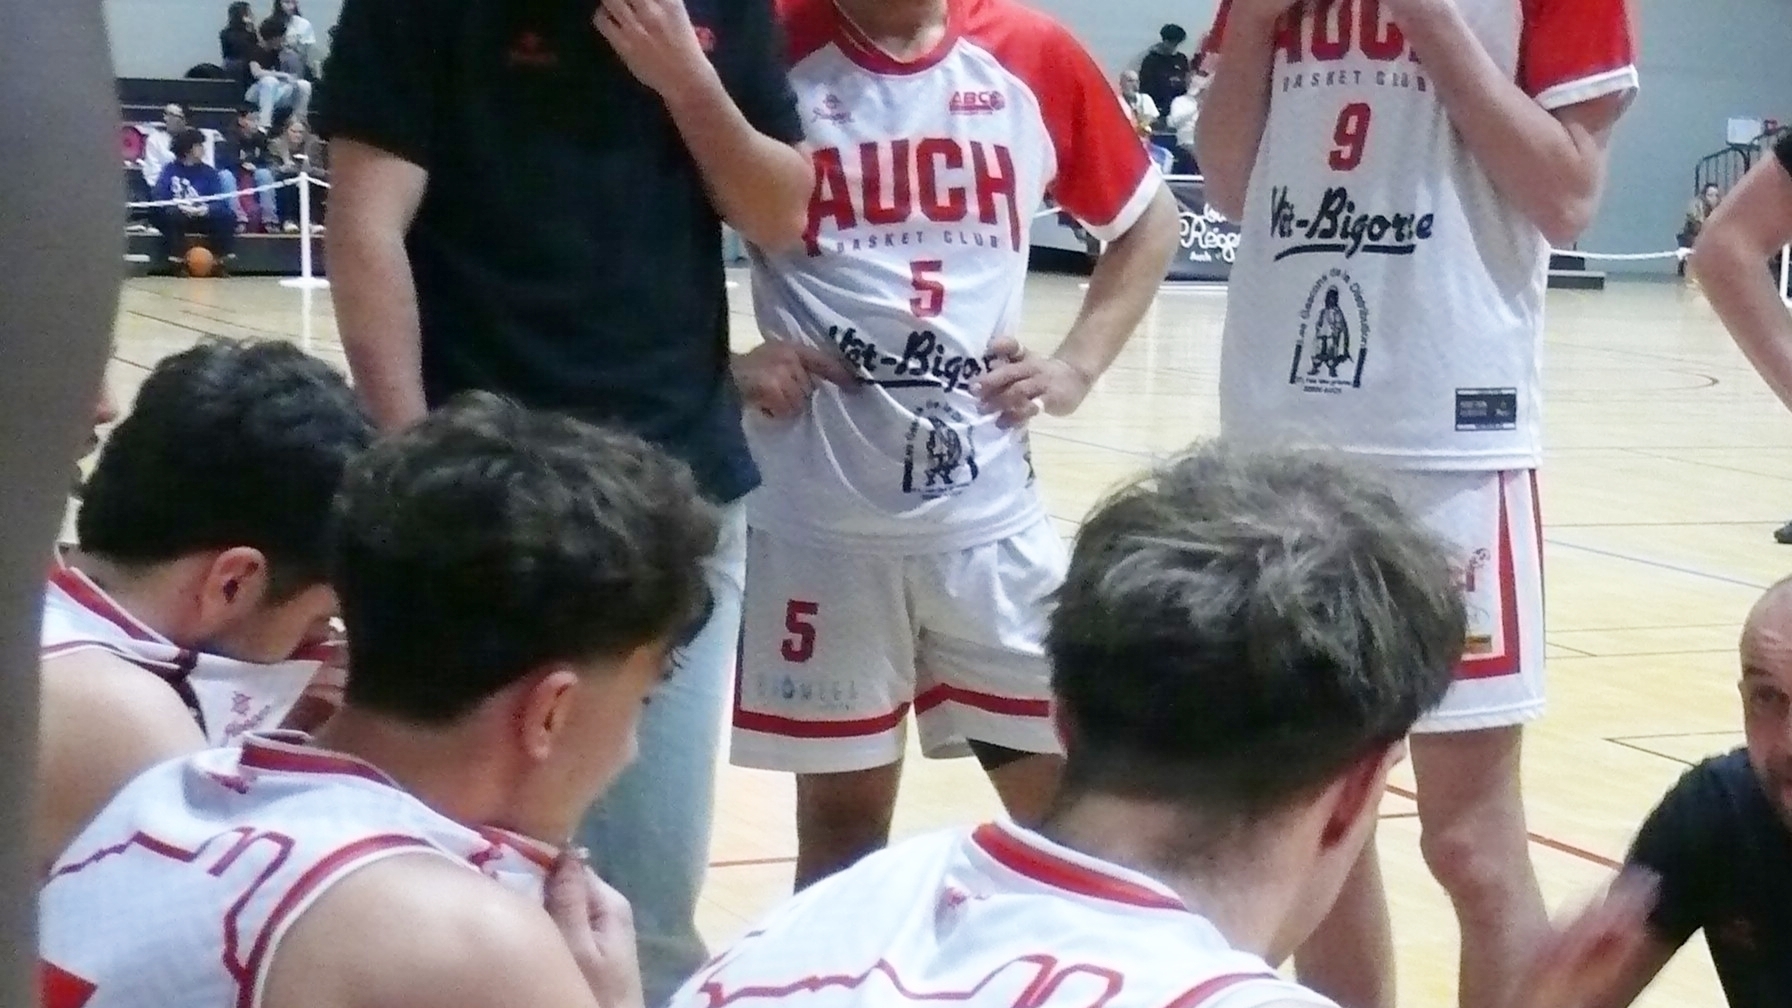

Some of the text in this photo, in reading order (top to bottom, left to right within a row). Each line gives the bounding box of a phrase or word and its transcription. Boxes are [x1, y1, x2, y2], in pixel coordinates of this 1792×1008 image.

[1327, 102, 1372, 171] 9
[801, 137, 1021, 258] AUCH
[836, 230, 998, 252] BASKET CLUB
[909, 260, 944, 318] 5
[780, 598, 819, 663] 5
